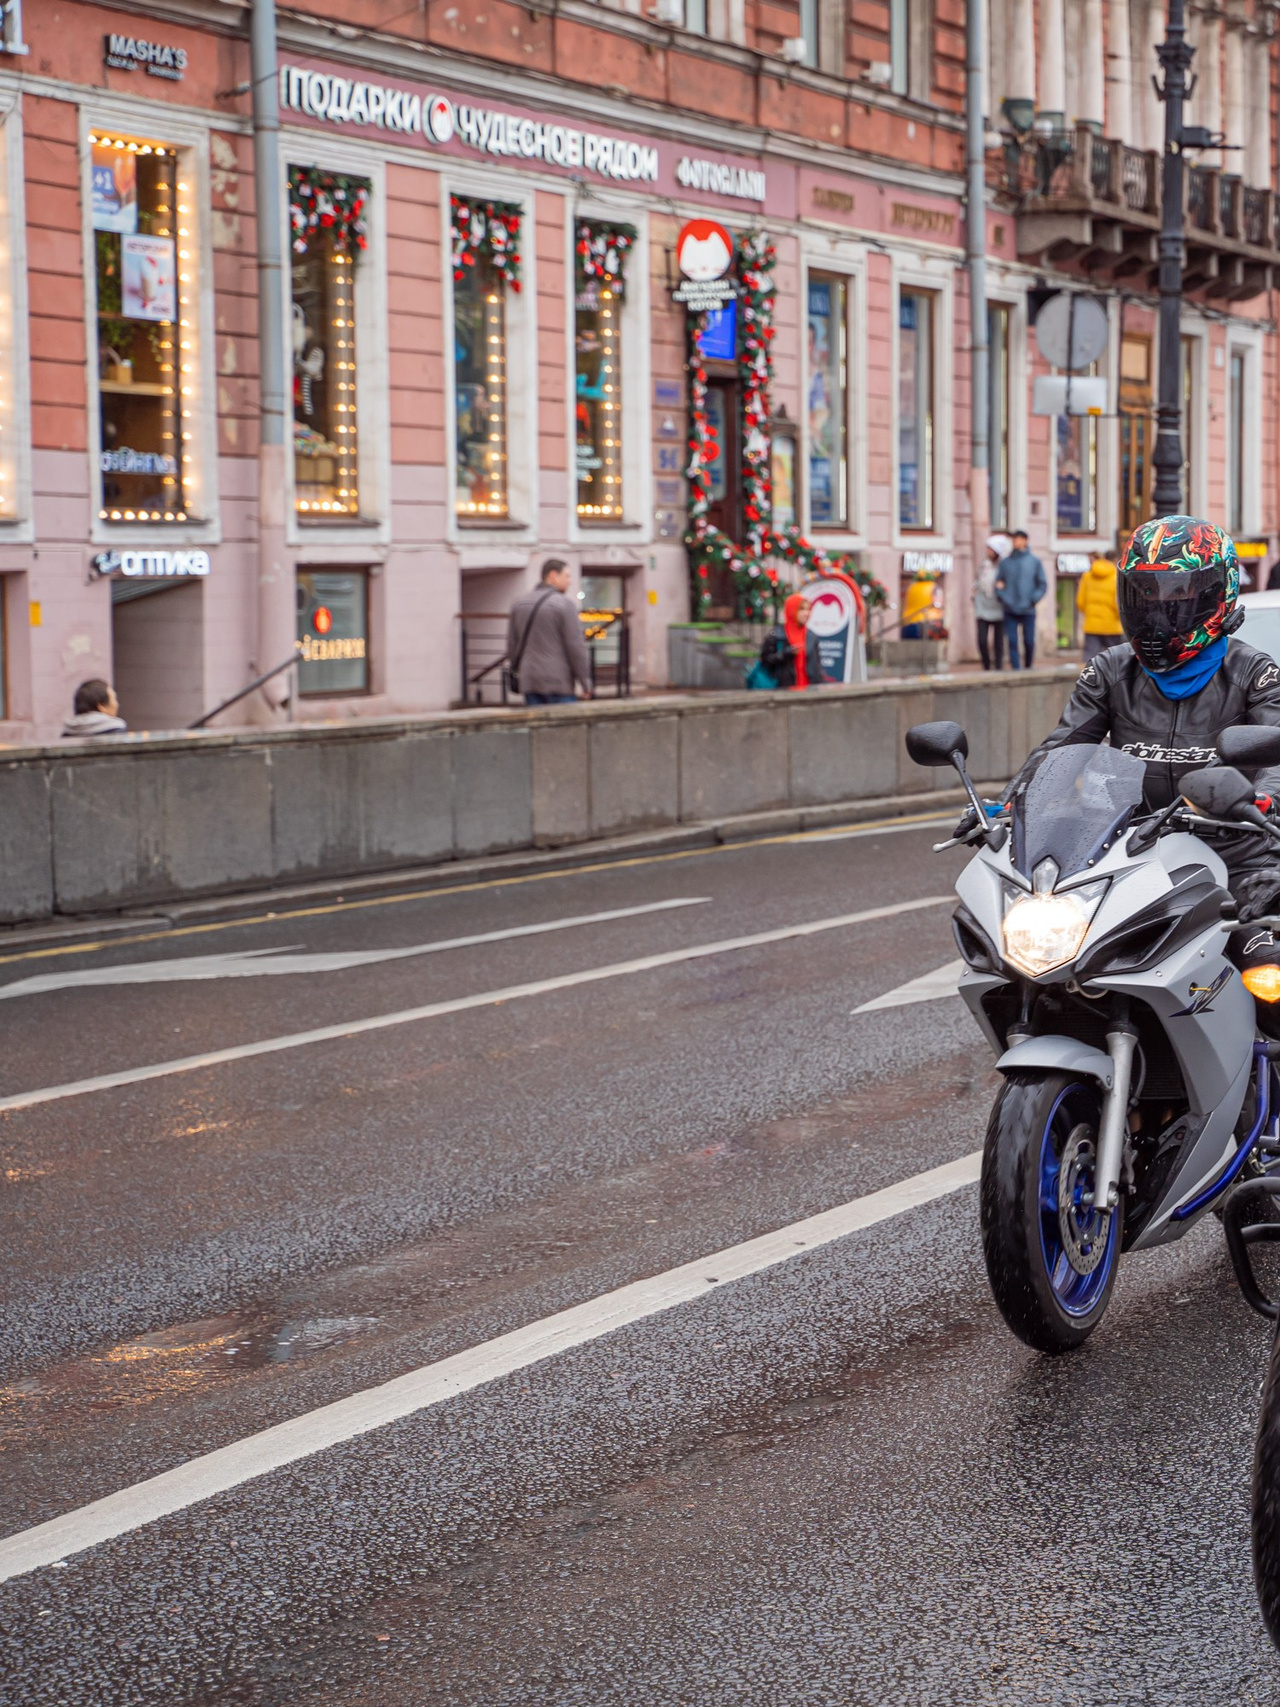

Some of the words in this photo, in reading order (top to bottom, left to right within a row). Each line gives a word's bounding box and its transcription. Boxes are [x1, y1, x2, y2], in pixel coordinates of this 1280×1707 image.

[108, 33, 188, 70] MASHA'S
[282, 65, 421, 135] ПОДАРКИ
[457, 103, 581, 168] ЧУДЕСНОЕ
[582, 132, 659, 182] РЯДОМ
